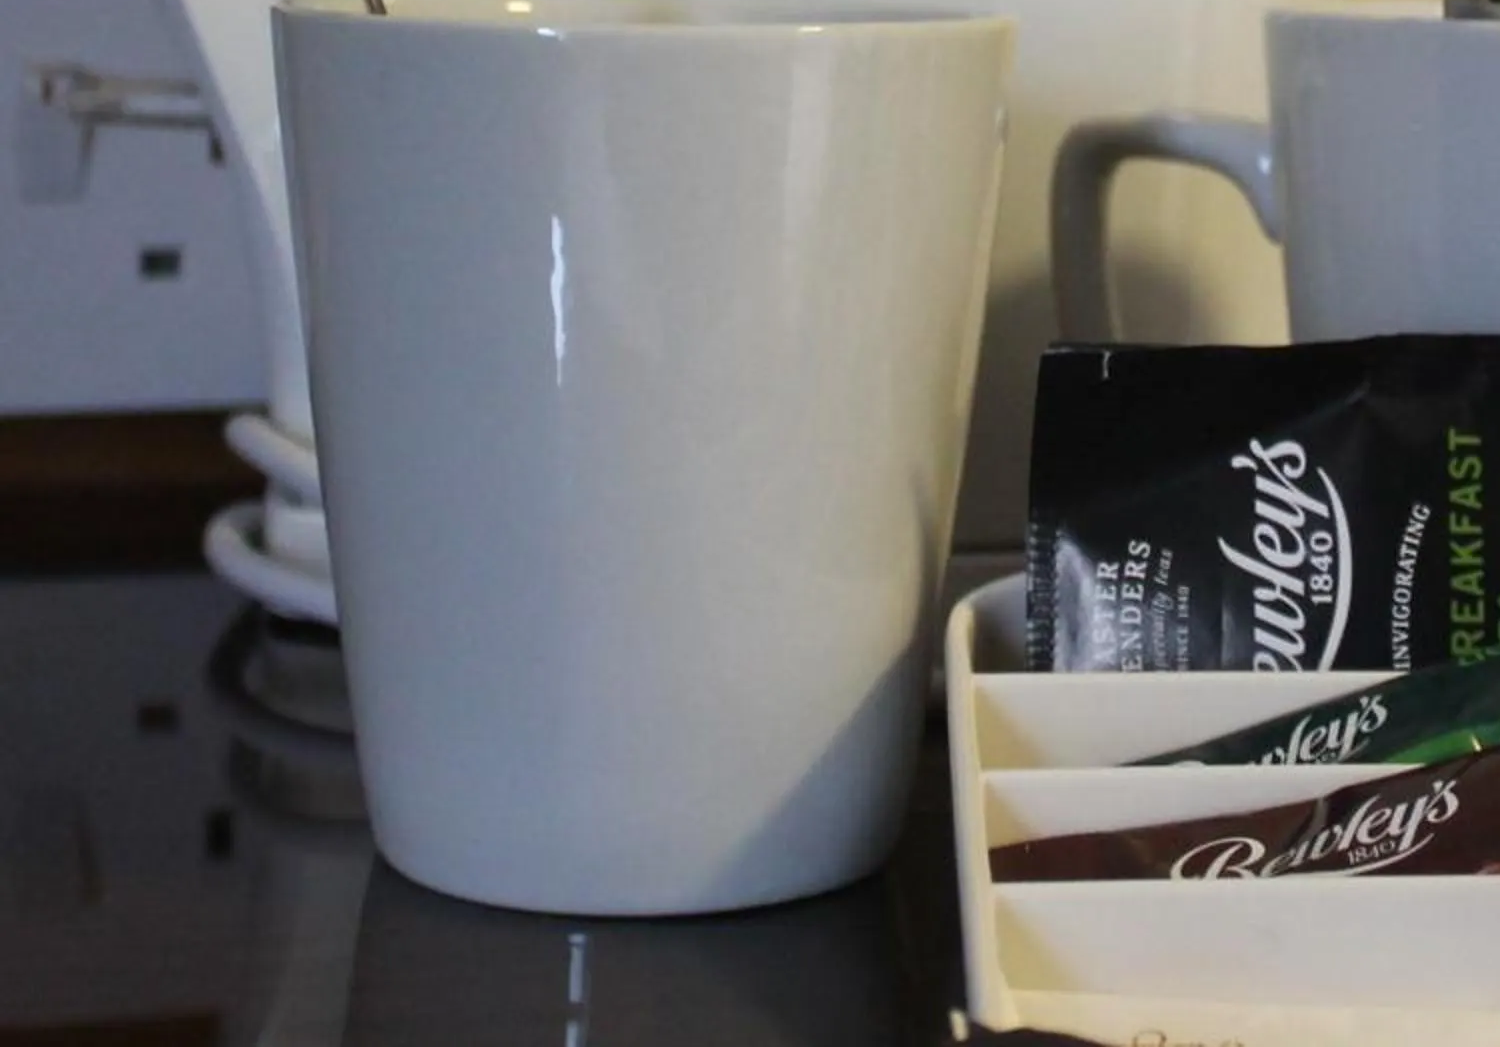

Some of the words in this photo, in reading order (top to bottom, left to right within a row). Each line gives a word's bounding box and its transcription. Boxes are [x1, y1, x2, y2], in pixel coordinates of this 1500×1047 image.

[1091, 561, 1119, 666] ASTER
[1119, 539, 1150, 672] ENDERS
[1217, 437, 1331, 672] ewley's
[1310, 531, 1334, 604] 1840
[1392, 502, 1431, 671] INVIGORATING
[1448, 427, 1483, 655] REAKFAST
